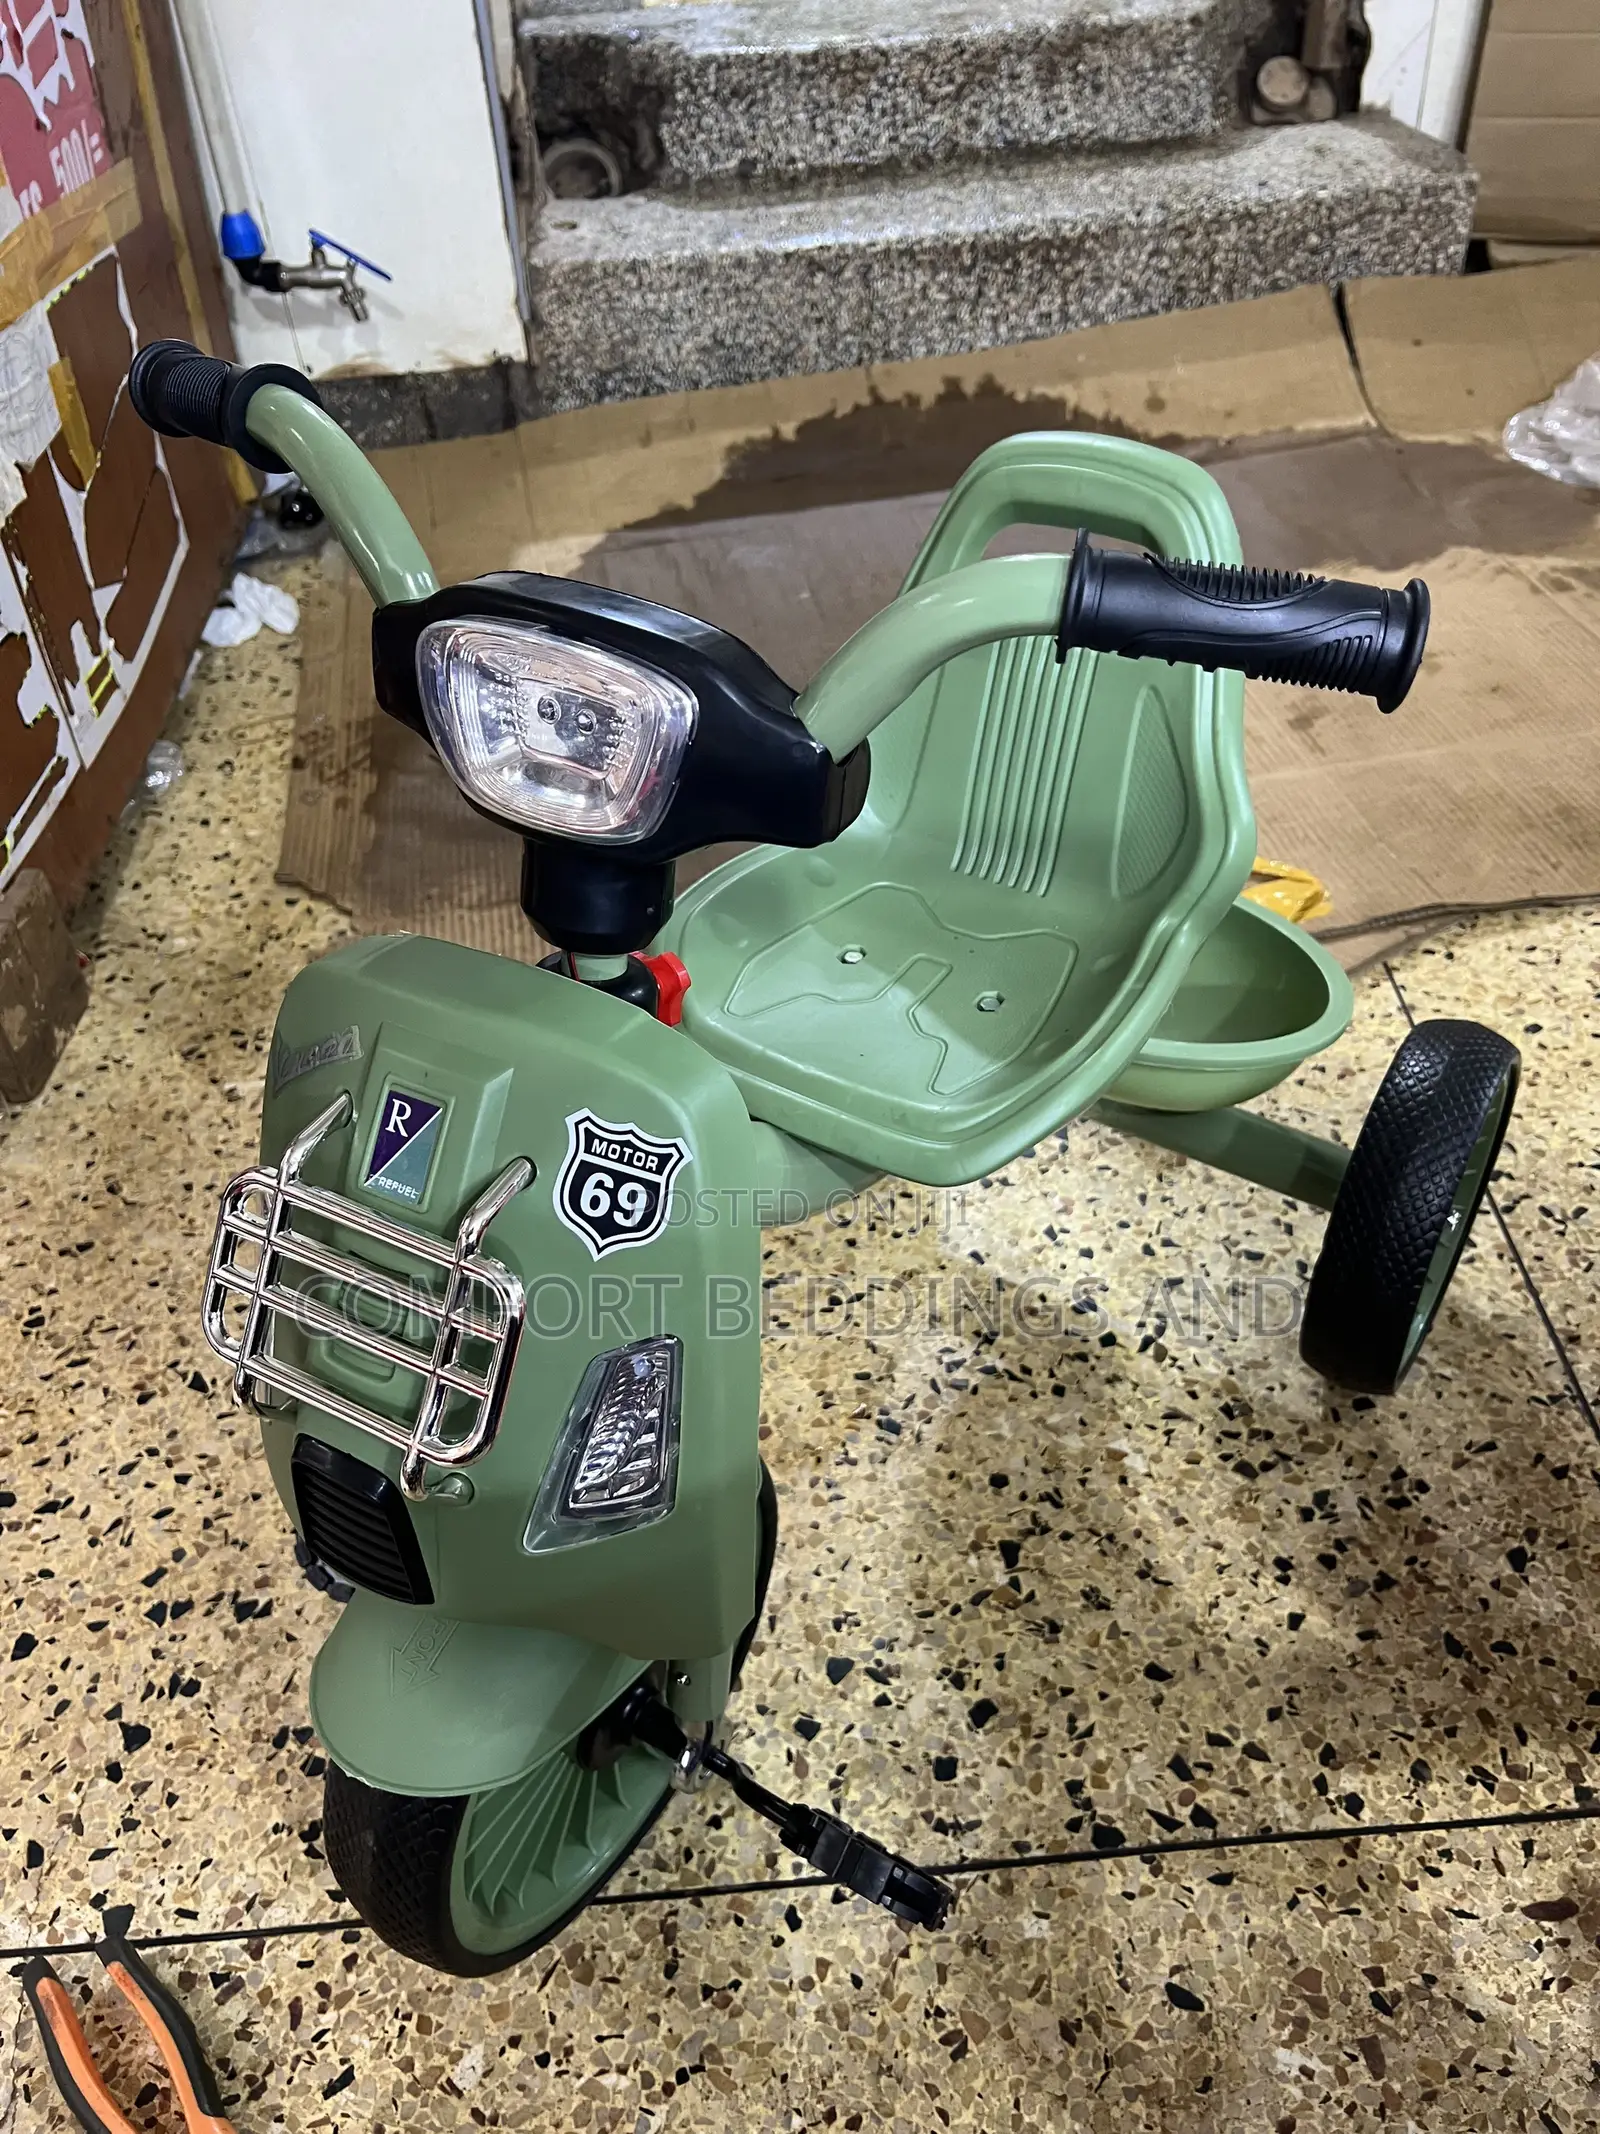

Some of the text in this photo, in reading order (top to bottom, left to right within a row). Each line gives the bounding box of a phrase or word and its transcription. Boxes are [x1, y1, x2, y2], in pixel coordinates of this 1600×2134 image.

[49, 119, 104, 217] 500/=
[384, 1098, 412, 1138] R
[591, 1138, 659, 1171] MOTOR
[377, 1176, 420, 1200] REFUEL
[579, 1172, 648, 1228] 69
[401, 1616, 449, 1684] RONT
